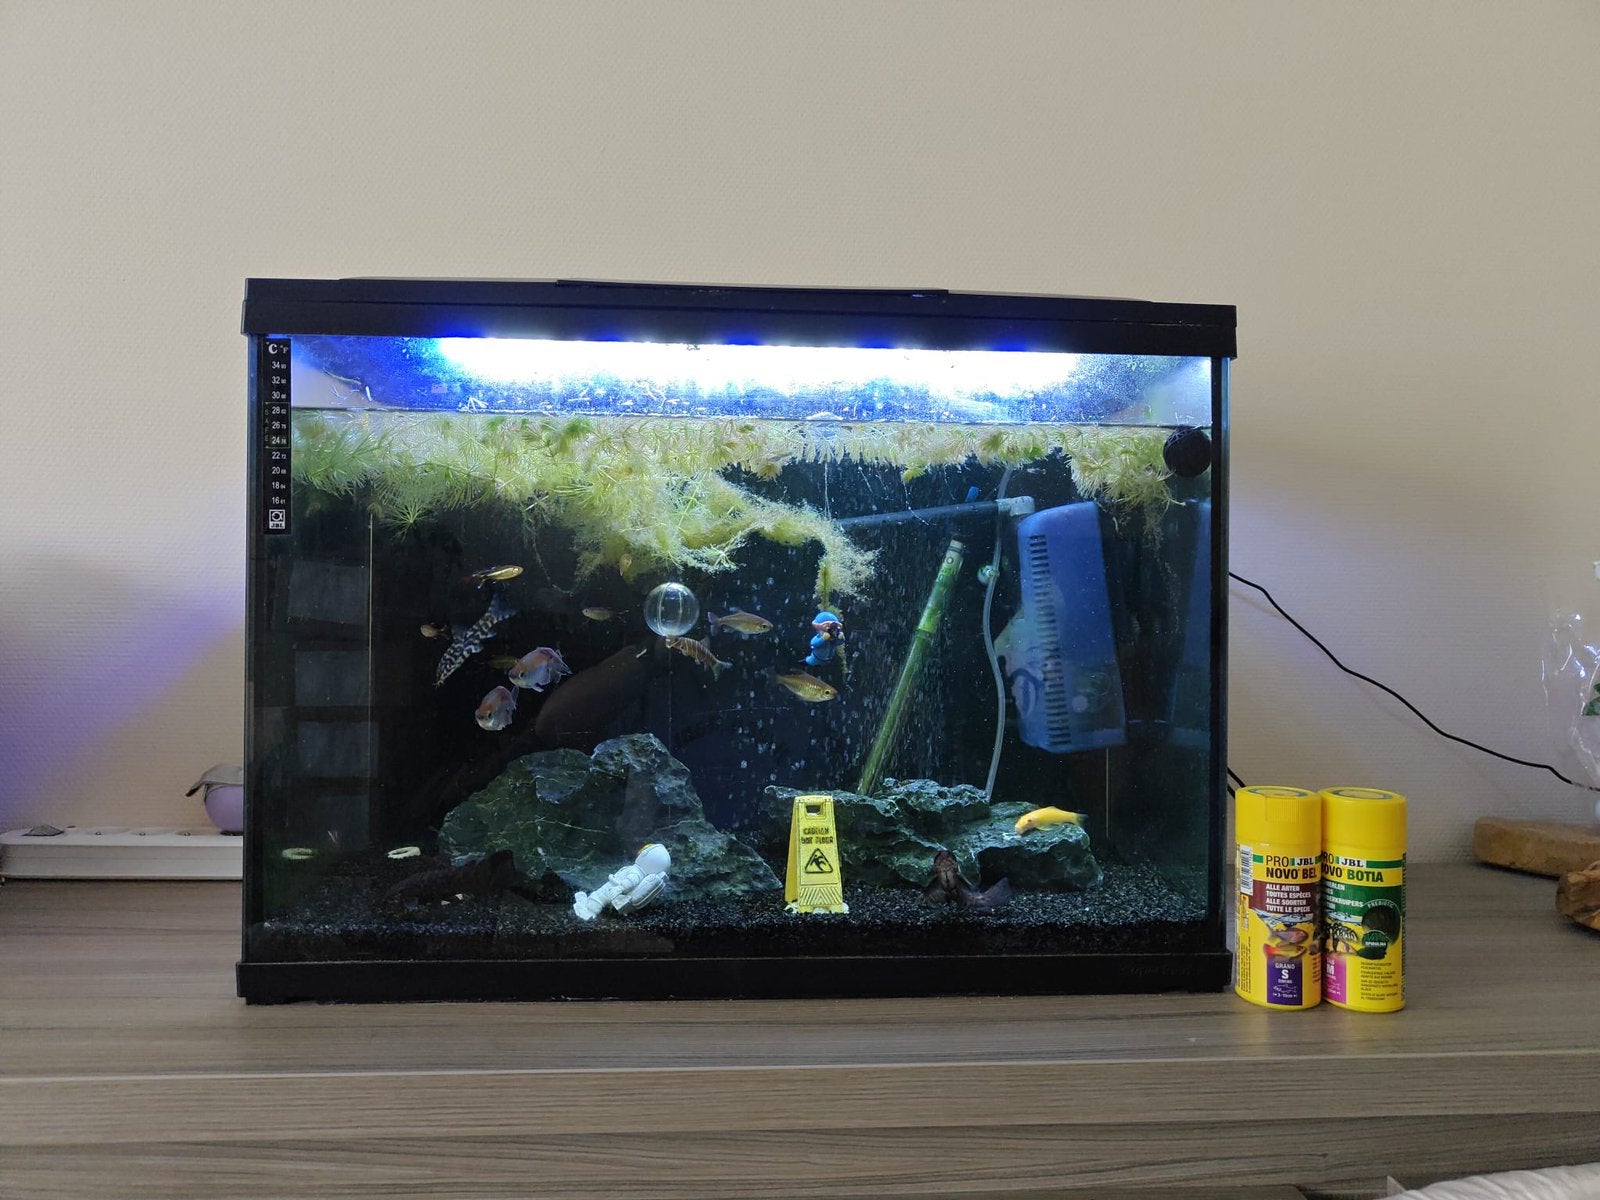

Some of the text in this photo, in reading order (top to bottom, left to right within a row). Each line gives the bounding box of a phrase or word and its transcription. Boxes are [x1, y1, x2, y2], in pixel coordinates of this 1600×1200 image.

[271, 361, 280, 369] 34
[271, 376, 281, 384] 32
[271, 391, 281, 399] 30
[271, 406, 281, 414] 28
[271, 421, 281, 429] 26
[271, 436, 280, 445] 24
[271, 451, 281, 459] 22
[271, 466, 281, 475] 20
[272, 481, 280, 490] 18
[272, 496, 280, 505] 16
[1266, 855, 1314, 868] PRO JBL
[1341, 858, 1364, 868] JBL
[1266, 867, 1317, 880] NOVO BEL
[1347, 869, 1384, 883] BOTIA
[1265, 883, 1300, 892] ALLE ARTEN
[1266, 891, 1288, 899] TOUTES
[1281, 969, 1289, 979] S
